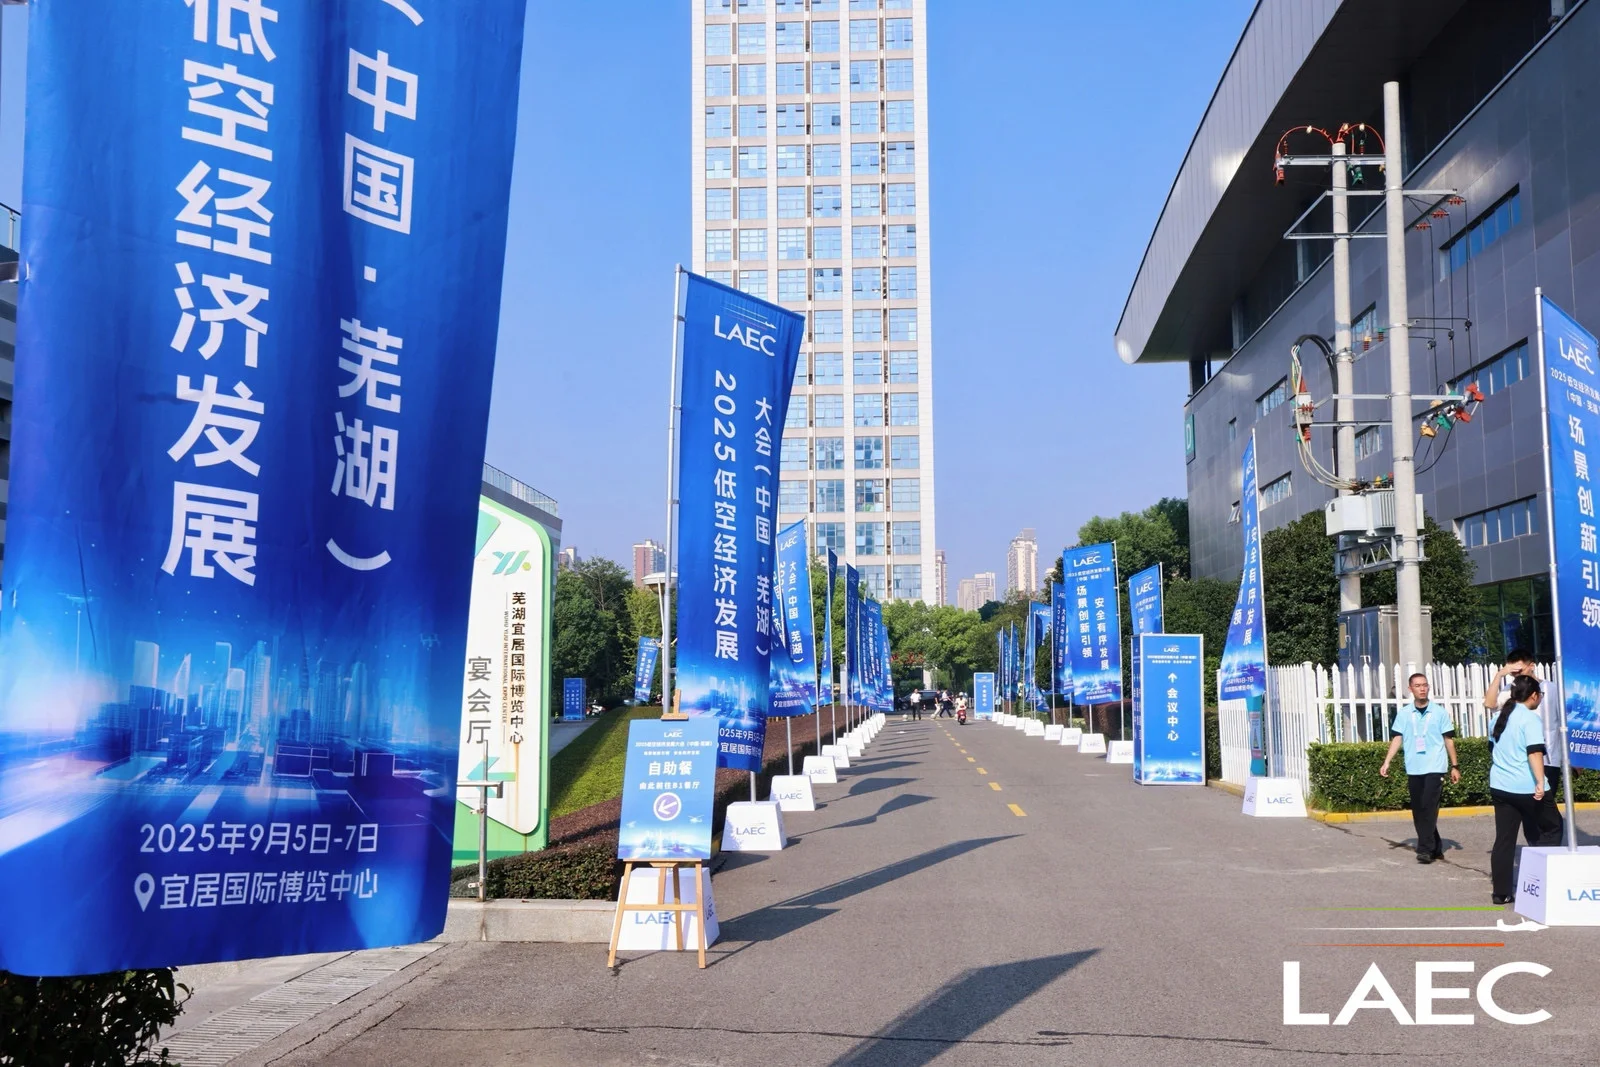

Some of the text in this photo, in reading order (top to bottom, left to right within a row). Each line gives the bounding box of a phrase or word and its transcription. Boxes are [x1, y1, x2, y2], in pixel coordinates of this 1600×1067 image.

[160, 0, 280, 587] 低空经济发展
[714, 315, 777, 357] LAEC
[1559, 336, 1595, 375] LAEC
[1186, 424, 1192, 450] D
[713, 369, 740, 662] 2025低空经济发展
[754, 396, 774, 657] 大会（中国·芜湖）
[1568, 413, 1600, 628] 场景创新引领
[780, 535, 798, 552] LAEC
[1073, 555, 1102, 568] LAEC
[1136, 581, 1154, 597] LAEC
[788, 560, 804, 663] 大会（中国·芜湖）
[1077, 585, 1093, 658] 场景创新引领
[1095, 597, 1110, 671] 安全有序发展
[510, 591, 526, 745] 芜湖宜居国际博览中心
[466, 655, 492, 745] 宴会厅
[1167, 688, 1179, 742] 会议中心
[648, 760, 693, 776] 自助餐
[779, 792, 803, 800] LAEC
[1266, 796, 1293, 804] LAEC
[139, 822, 380, 856] 2025年9月5日-7日
[735, 826, 766, 836] LAEC
[159, 869, 379, 911] 宜居国际博览中心
[1523, 879, 1540, 899] LAEC
